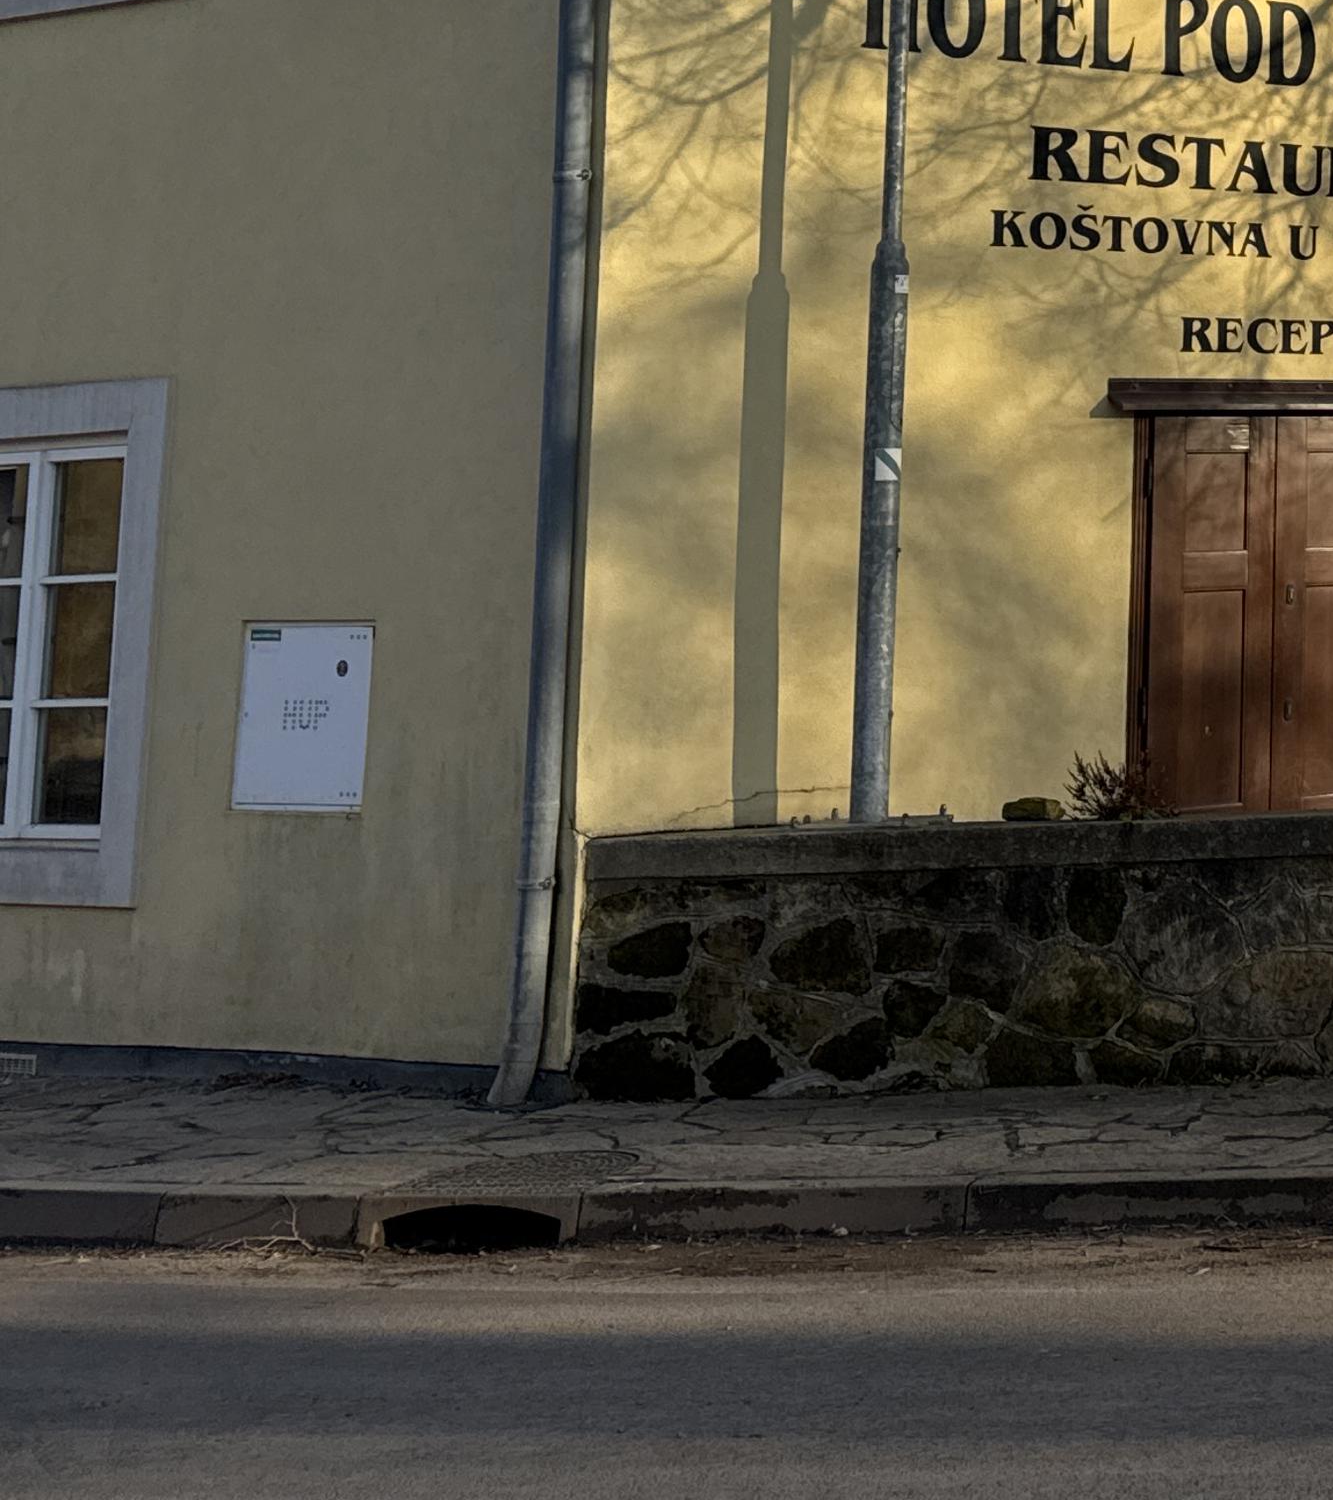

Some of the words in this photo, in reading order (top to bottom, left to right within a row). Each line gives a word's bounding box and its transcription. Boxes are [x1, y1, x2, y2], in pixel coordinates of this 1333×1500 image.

[989, 205, 1270, 258] KOŠTOVNA
[1289, 225, 1319, 261] U
[283, 699, 330, 731] HUP
